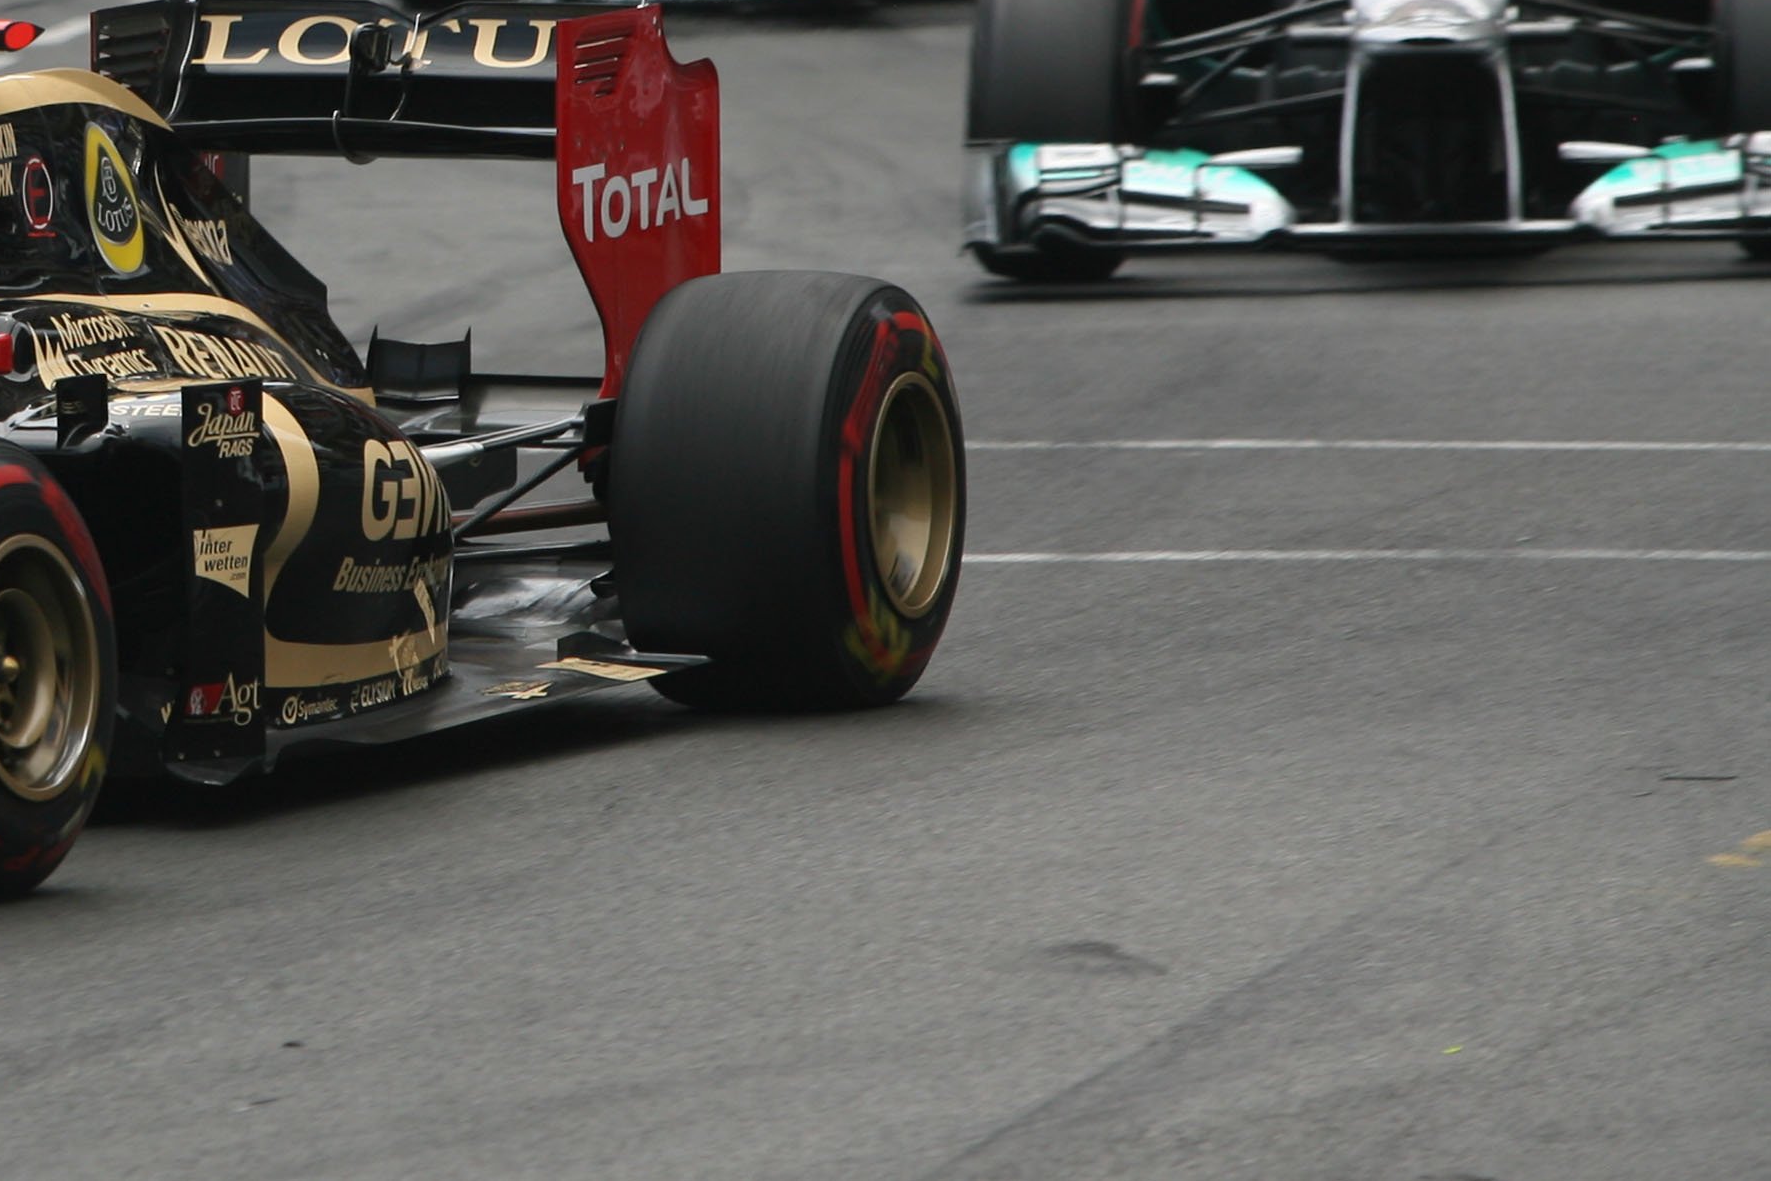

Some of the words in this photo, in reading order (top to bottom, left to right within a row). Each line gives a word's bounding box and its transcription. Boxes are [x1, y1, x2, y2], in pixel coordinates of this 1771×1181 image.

[97, 196, 134, 233] LOTUS
[572, 156, 709, 243] TOTAL
[50, 312, 134, 351] Microsoft
[152, 325, 298, 380] RENAULT
[110, 403, 182, 417] STEE
[188, 402, 256, 447] Japan
[218, 438, 254, 459] RAGS
[204, 555, 248, 572] wetten
[332, 556, 407, 593] Business
